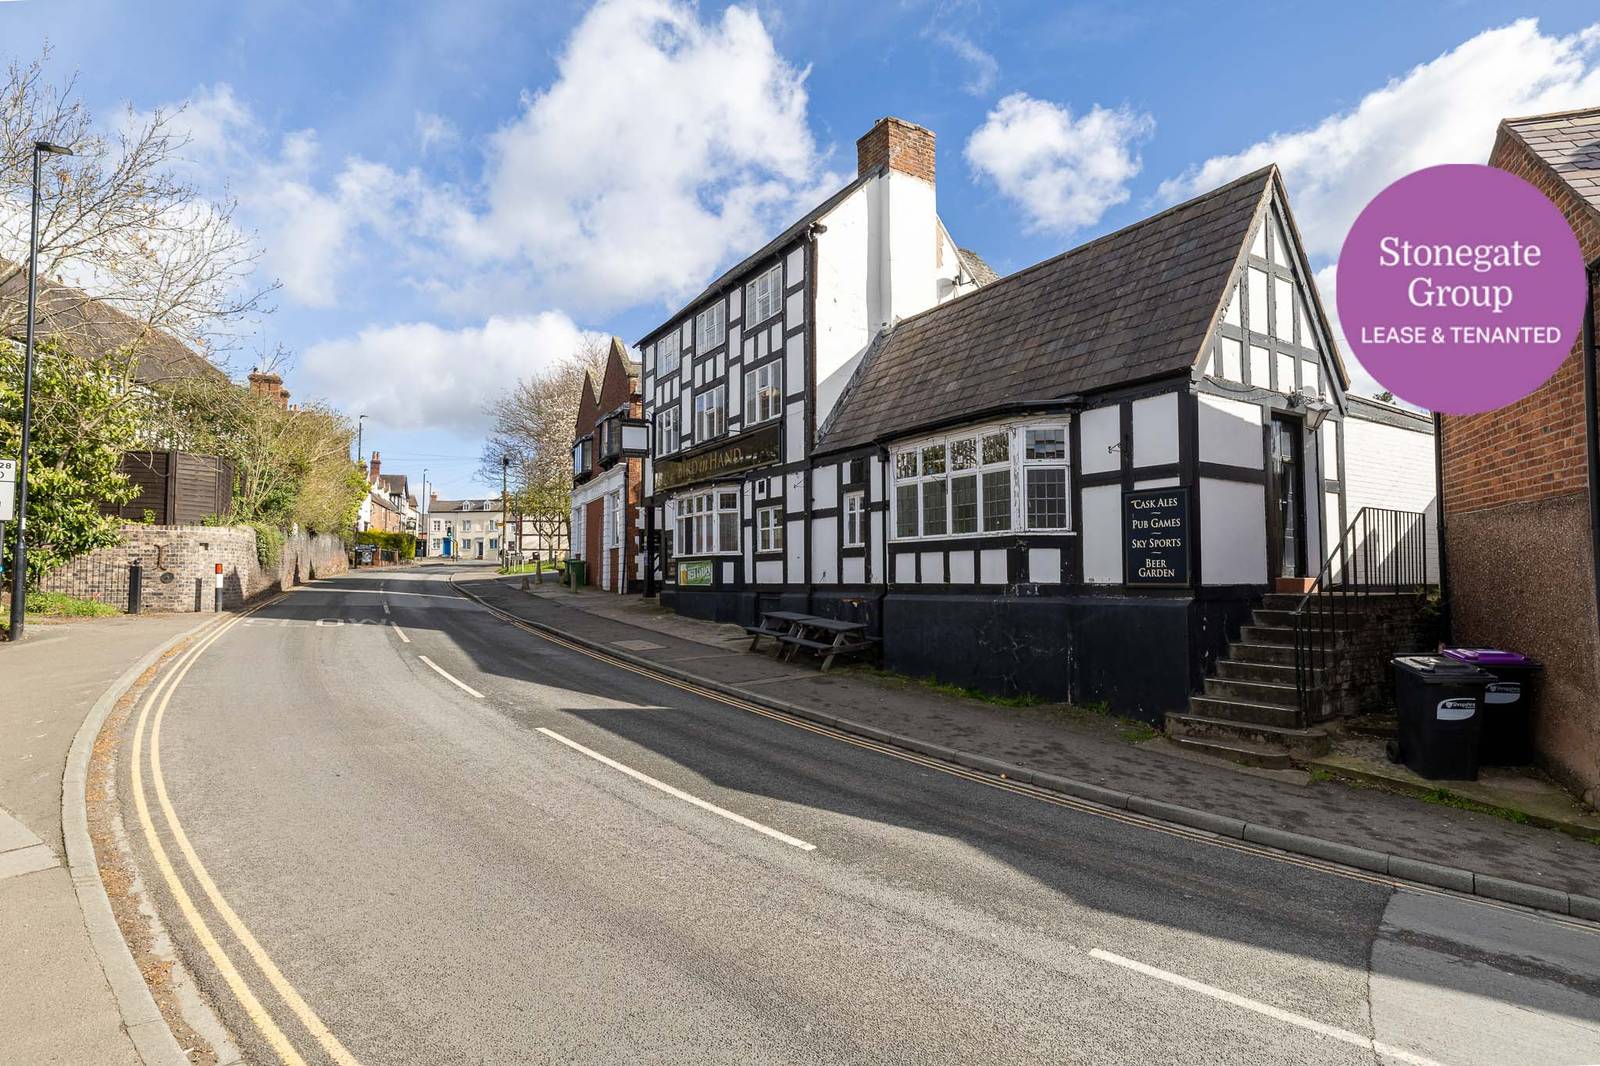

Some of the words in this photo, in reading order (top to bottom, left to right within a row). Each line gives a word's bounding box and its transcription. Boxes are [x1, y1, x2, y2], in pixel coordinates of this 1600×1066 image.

[710, 447, 742, 470] HAND
[1134, 500, 1156, 509] CASK
[1157, 498, 1178, 507] ALES
[1132, 520, 1149, 529] PUB
[1151, 518, 1181, 528] GAMES
[1132, 539, 1147, 549] SKY
[1149, 538, 1181, 548] SPORTS
[1146, 559, 1167, 568] BEER
[1138, 568, 1175, 577] GARDEN
[243, 617, 388, 627] SLOW
